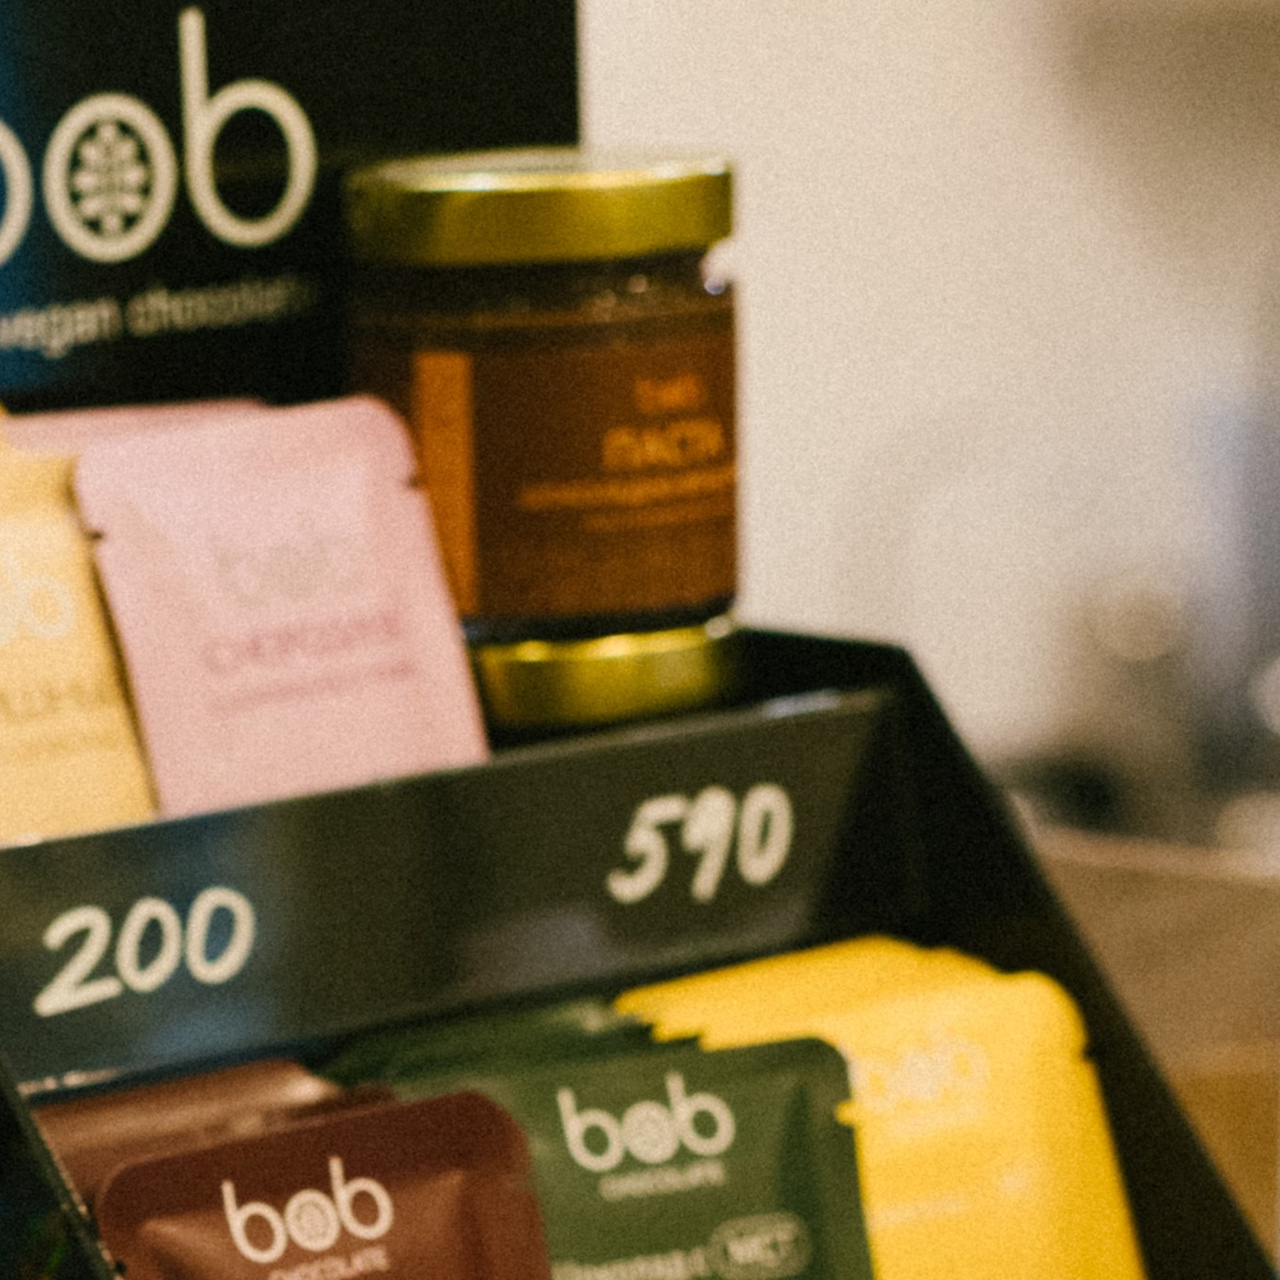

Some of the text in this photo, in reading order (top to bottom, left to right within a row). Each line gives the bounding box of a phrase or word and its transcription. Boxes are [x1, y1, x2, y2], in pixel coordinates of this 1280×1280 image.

[605, 783, 795, 904] 590
[34, 886, 258, 1017] 200
[556, 1070, 736, 1172] bob
[221, 1155, 395, 1264] bob
